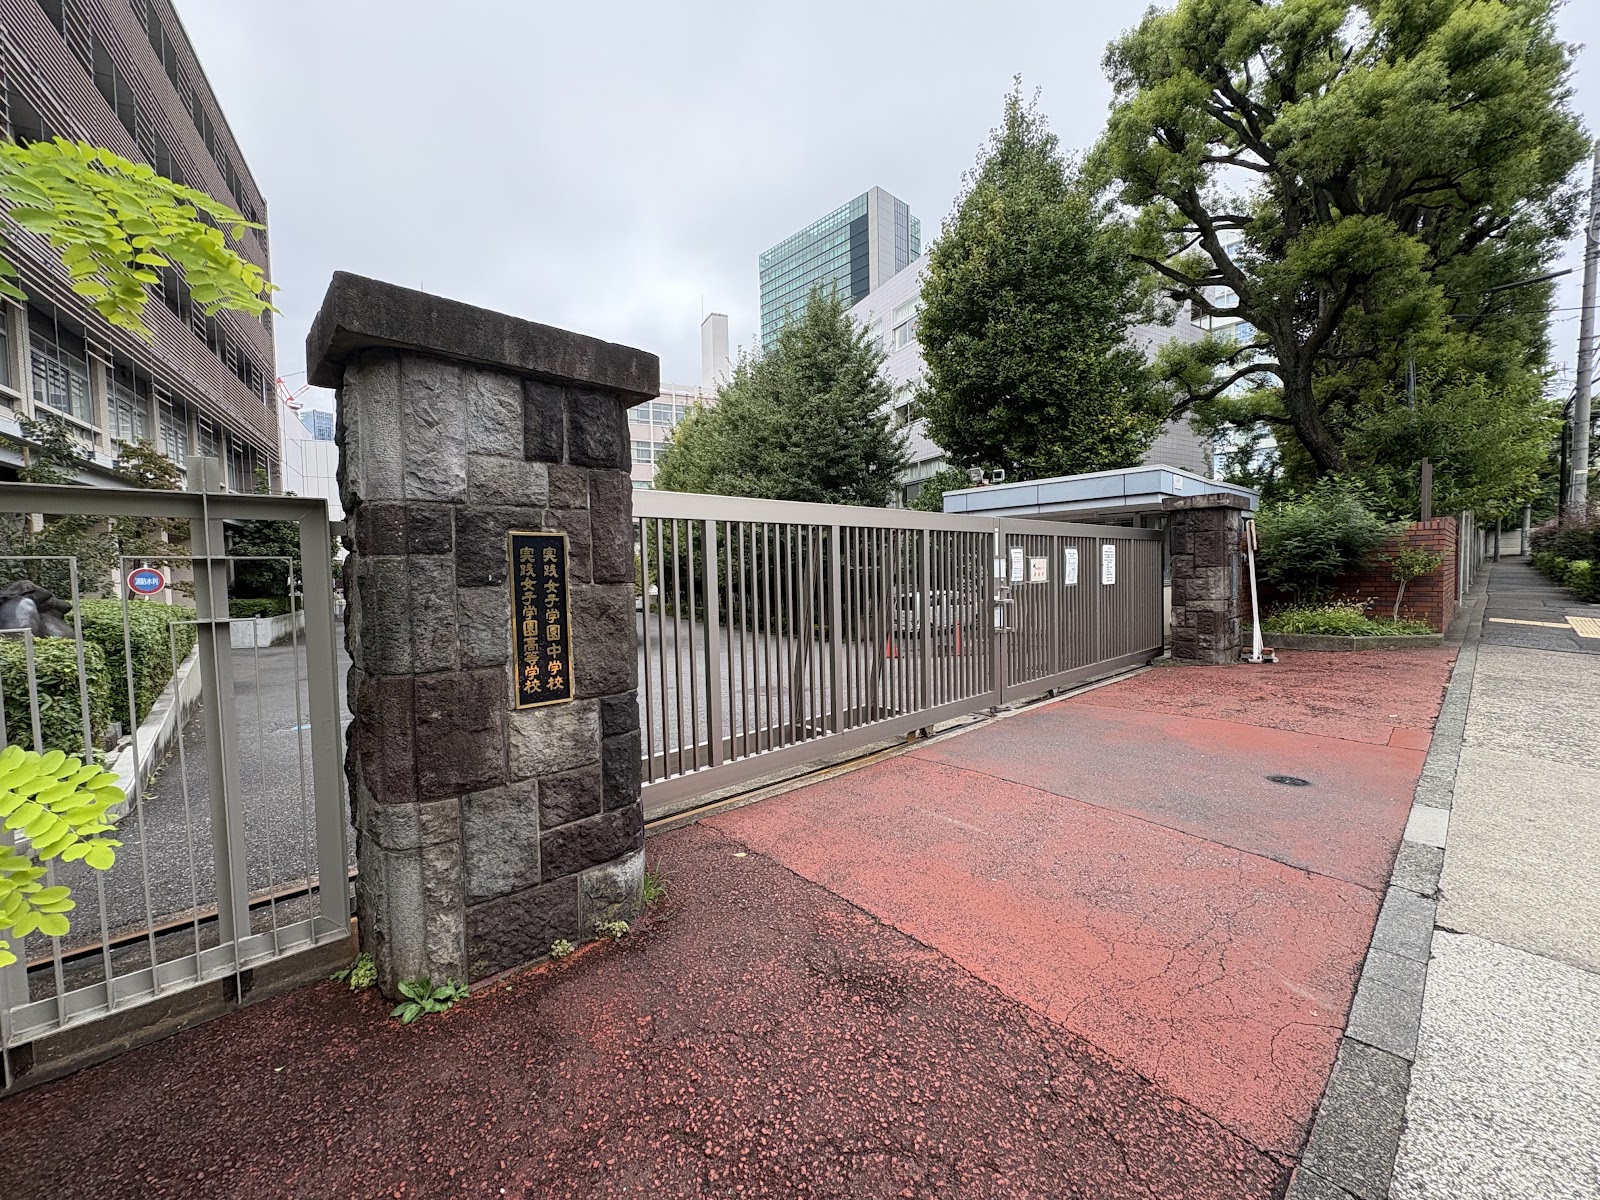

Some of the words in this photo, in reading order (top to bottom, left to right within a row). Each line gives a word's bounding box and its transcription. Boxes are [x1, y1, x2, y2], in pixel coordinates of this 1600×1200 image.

[519, 546, 542, 694] 実践女子学園高等学校
[542, 546, 564, 690] 実践女子学園中学校
